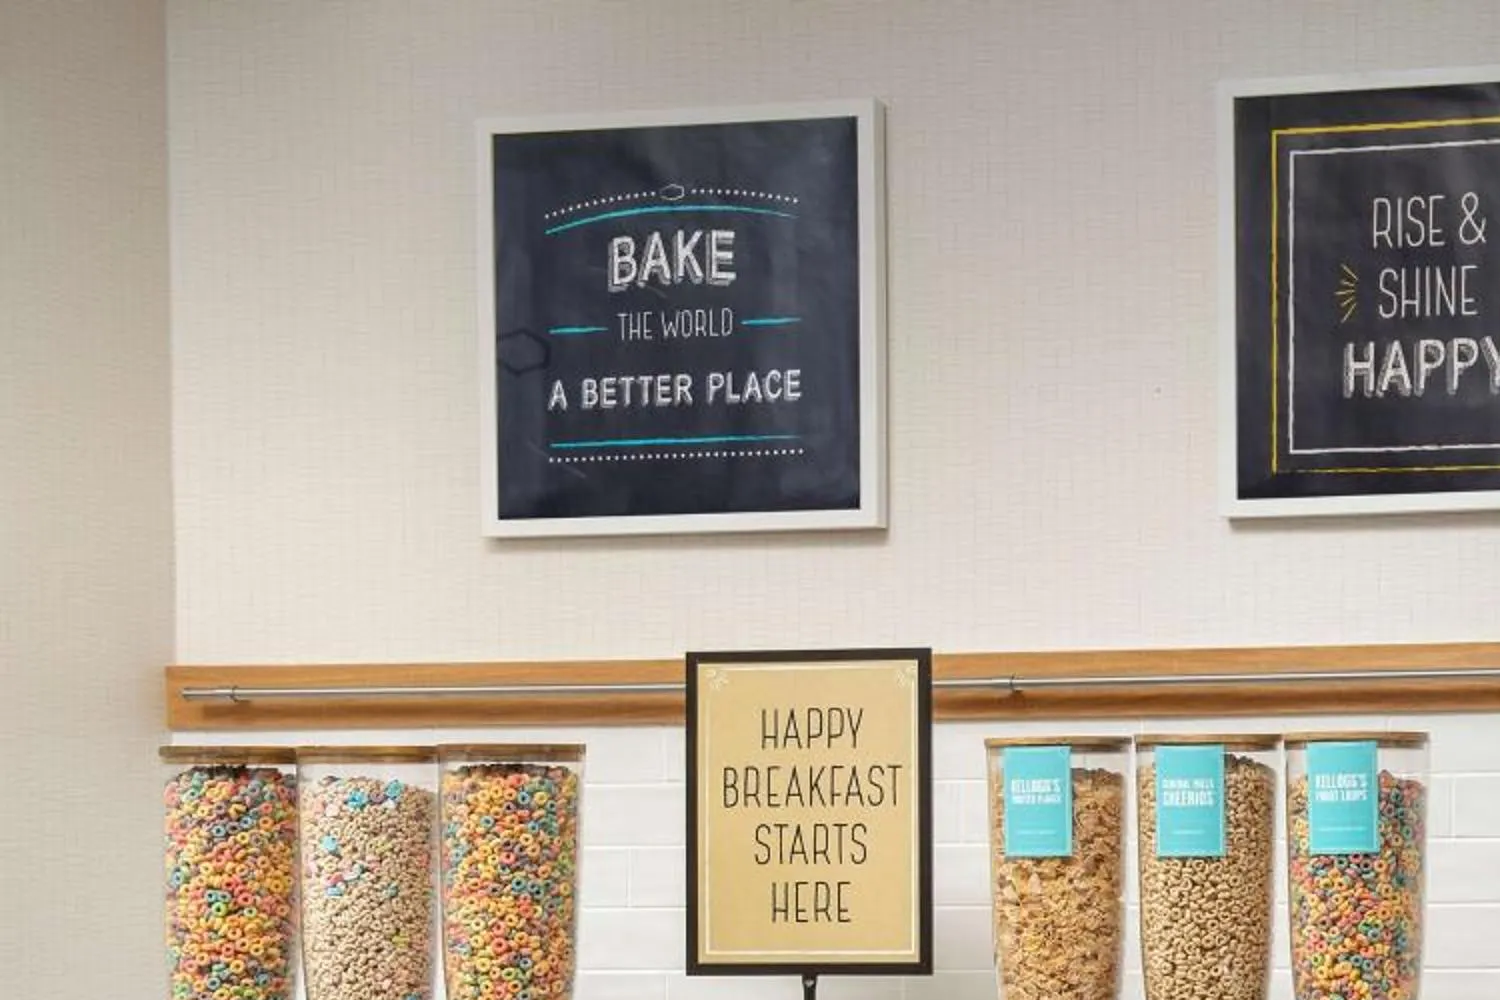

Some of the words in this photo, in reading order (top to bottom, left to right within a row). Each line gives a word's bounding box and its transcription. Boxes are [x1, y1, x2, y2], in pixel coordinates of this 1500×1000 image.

[1372, 194, 1445, 249] RISE
[1458, 191, 1487, 244] &
[607, 229, 737, 293] BAKE
[1378, 265, 1478, 319] SHINE
[618, 311, 653, 341] THE
[661, 307, 734, 340] WORLD
[547, 379, 568, 412] A
[581, 374, 694, 409] BETTER
[706, 368, 802, 404] PLACE
[761, 707, 864, 749] HAPPY
[723, 764, 903, 808] BREAKFAST
[754, 823, 868, 865] STARTS
[771, 881, 852, 923] HERE
